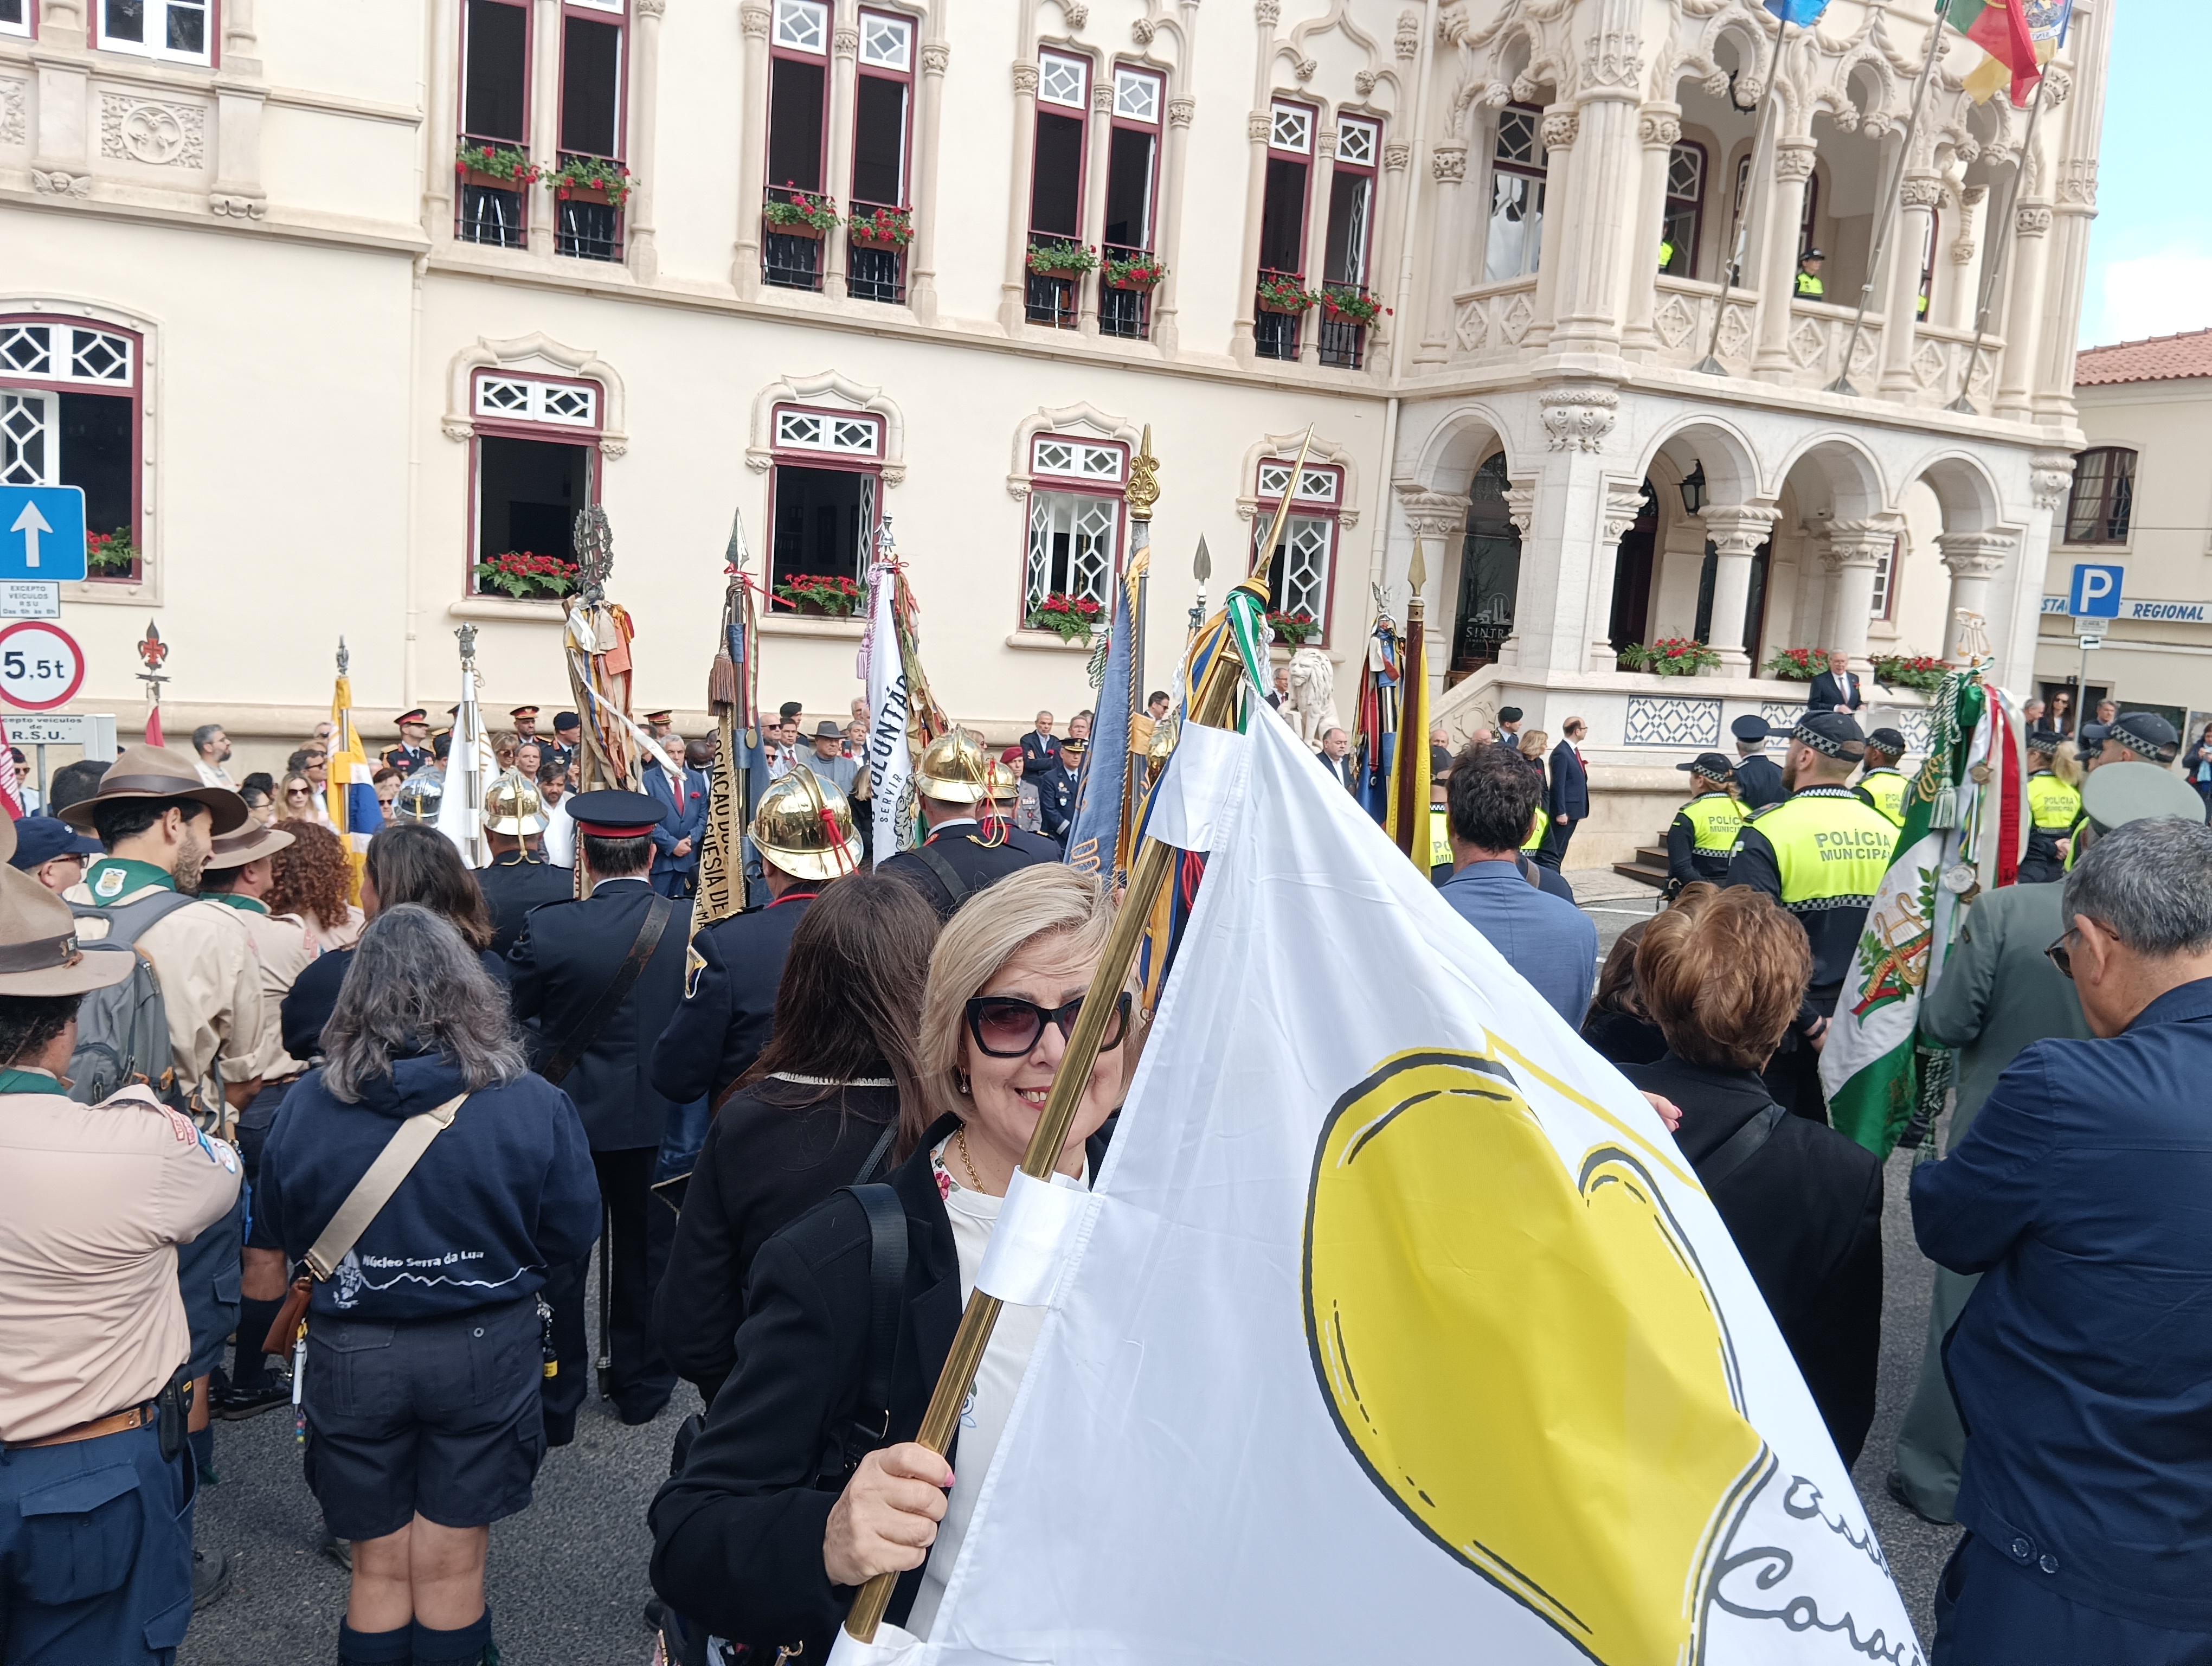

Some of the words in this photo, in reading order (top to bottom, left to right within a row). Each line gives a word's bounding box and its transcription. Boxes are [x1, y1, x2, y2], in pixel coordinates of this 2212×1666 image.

[2079, 568, 2113, 613] P
[2132, 603, 2204, 620] REGIONAL
[1465, 626, 1508, 639] SINTR
[12, 731, 65, 740] R.S.U.
[880, 773, 902, 823] SERVIR
[1708, 815, 1741, 825] POLÍC
[1709, 825, 1740, 834] MUNICI
[1814, 828, 1891, 849] POLÍCIA
[696, 898, 704, 910] DE
[696, 911, 710, 931] MA
[362, 1254, 404, 1268] Núcleo
[406, 1257, 442, 1267] Serra
[443, 1252, 459, 1265] da
[461, 1250, 485, 1260] Lua
